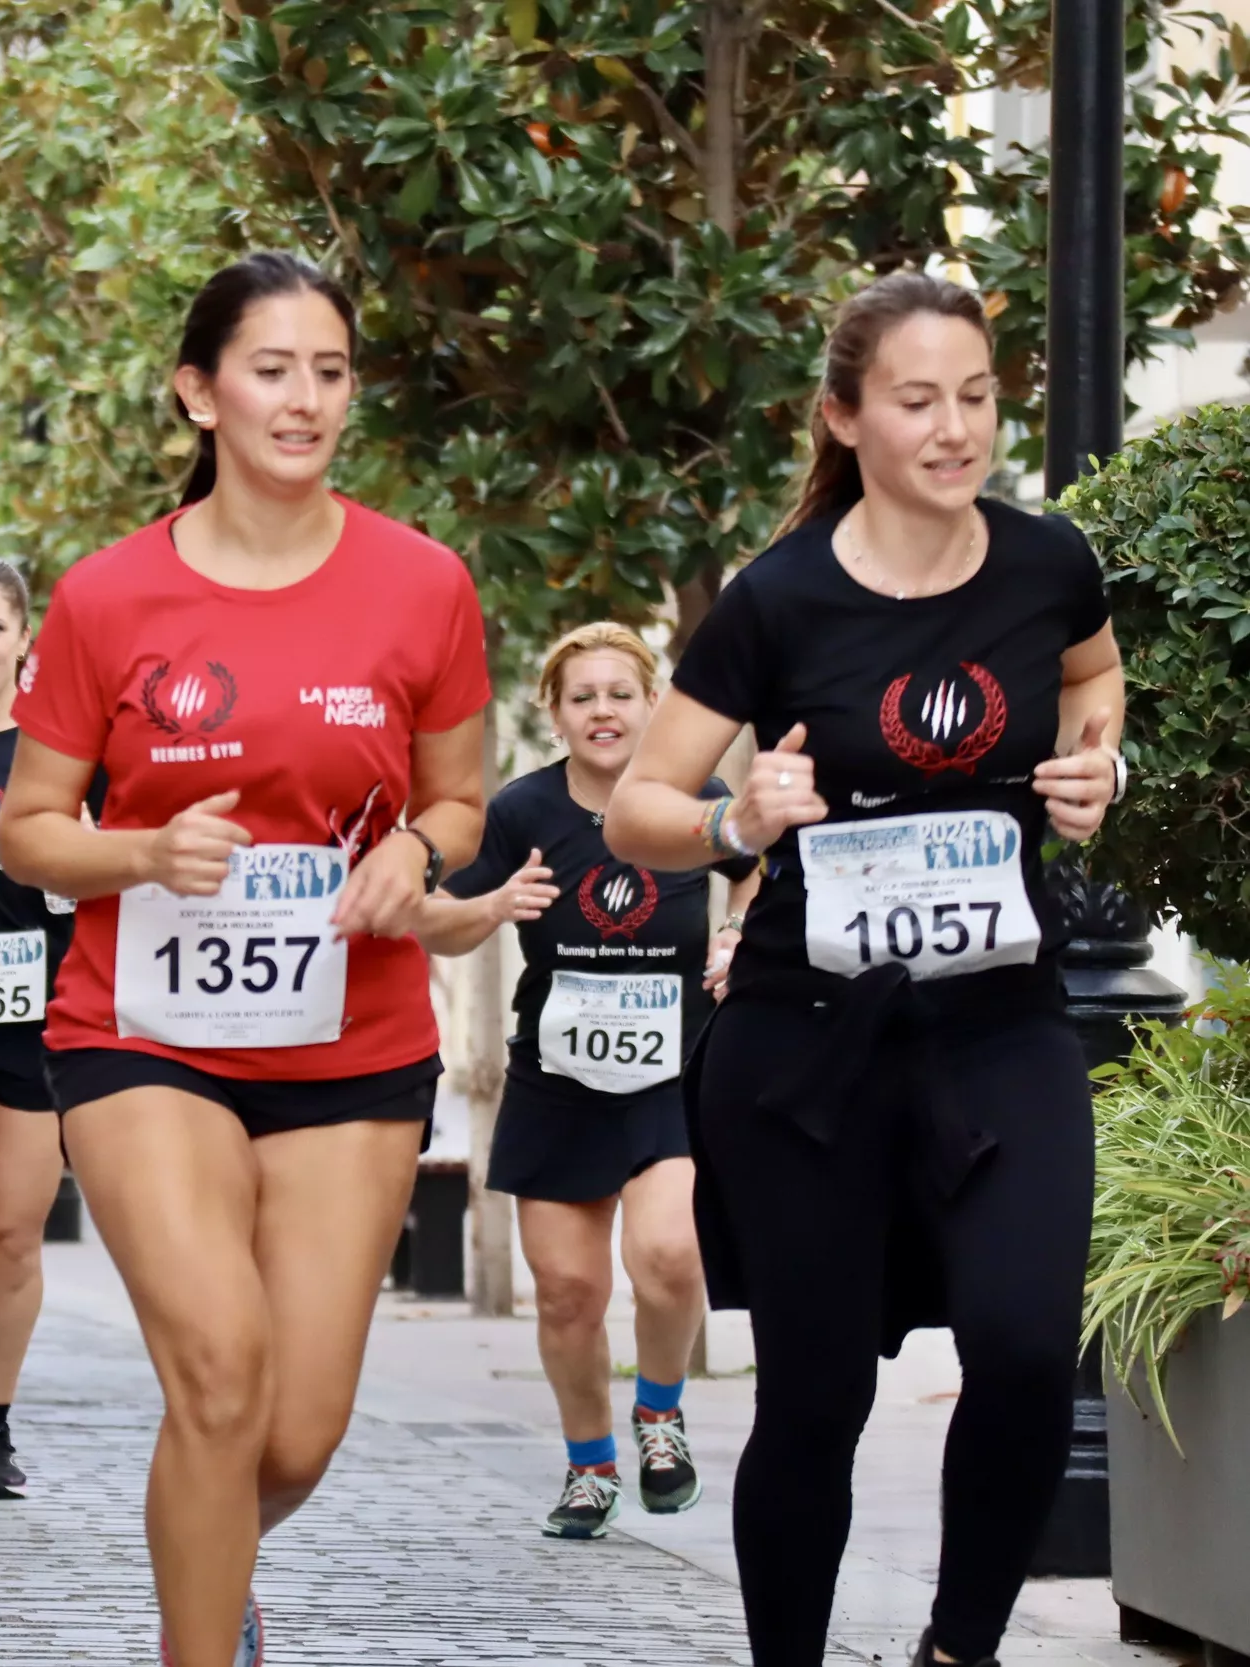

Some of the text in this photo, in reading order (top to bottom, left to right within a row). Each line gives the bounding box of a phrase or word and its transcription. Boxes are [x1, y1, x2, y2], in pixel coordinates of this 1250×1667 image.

[300, 686, 323, 705] LA
[324, 702, 386, 728] NEGRA
[151, 741, 243, 763] HERMES GYM
[243, 851, 299, 876] 2024
[845, 902, 1002, 964] 1057
[556, 942, 677, 959] Running down the street
[155, 936, 321, 994] 1357
[561, 1026, 664, 1066] 1052
